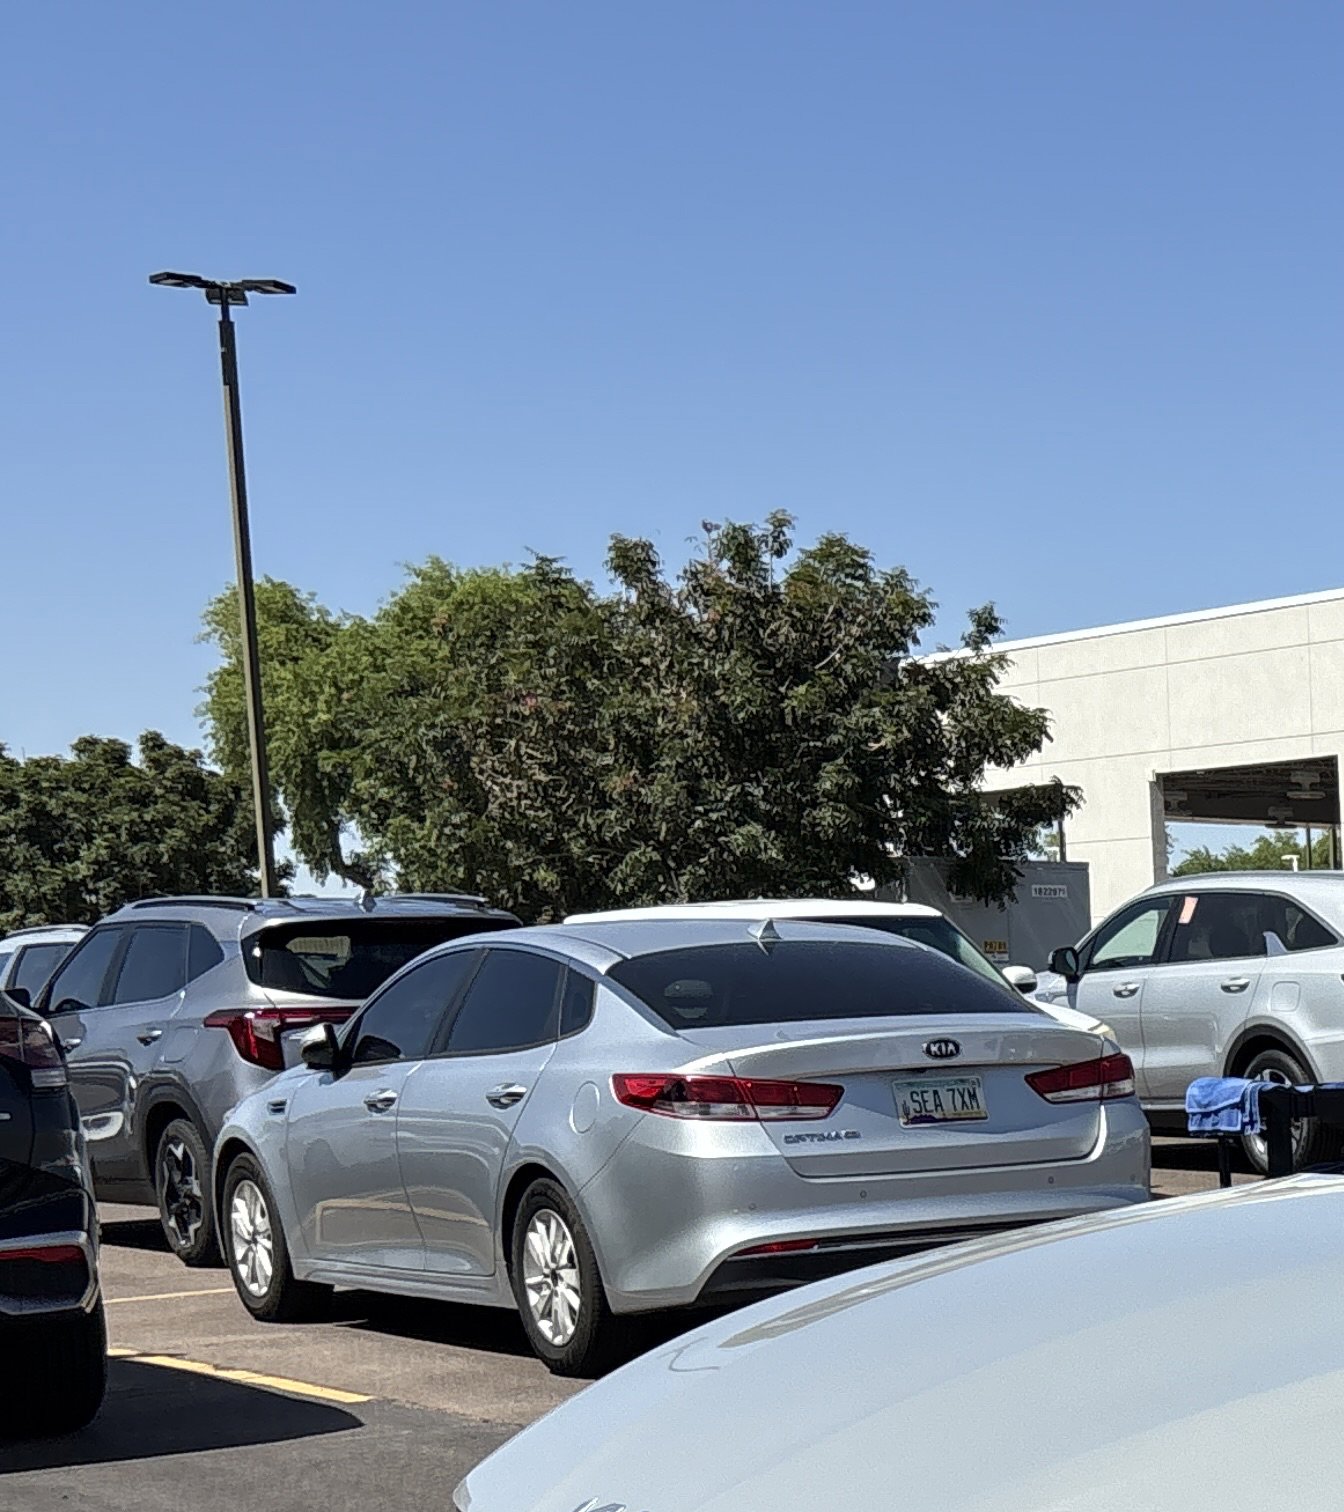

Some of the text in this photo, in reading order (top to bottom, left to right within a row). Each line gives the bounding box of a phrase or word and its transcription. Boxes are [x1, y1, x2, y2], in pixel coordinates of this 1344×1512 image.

[930, 1042, 957, 1056] KIA
[910, 1086, 981, 1114] SEA 7XM
